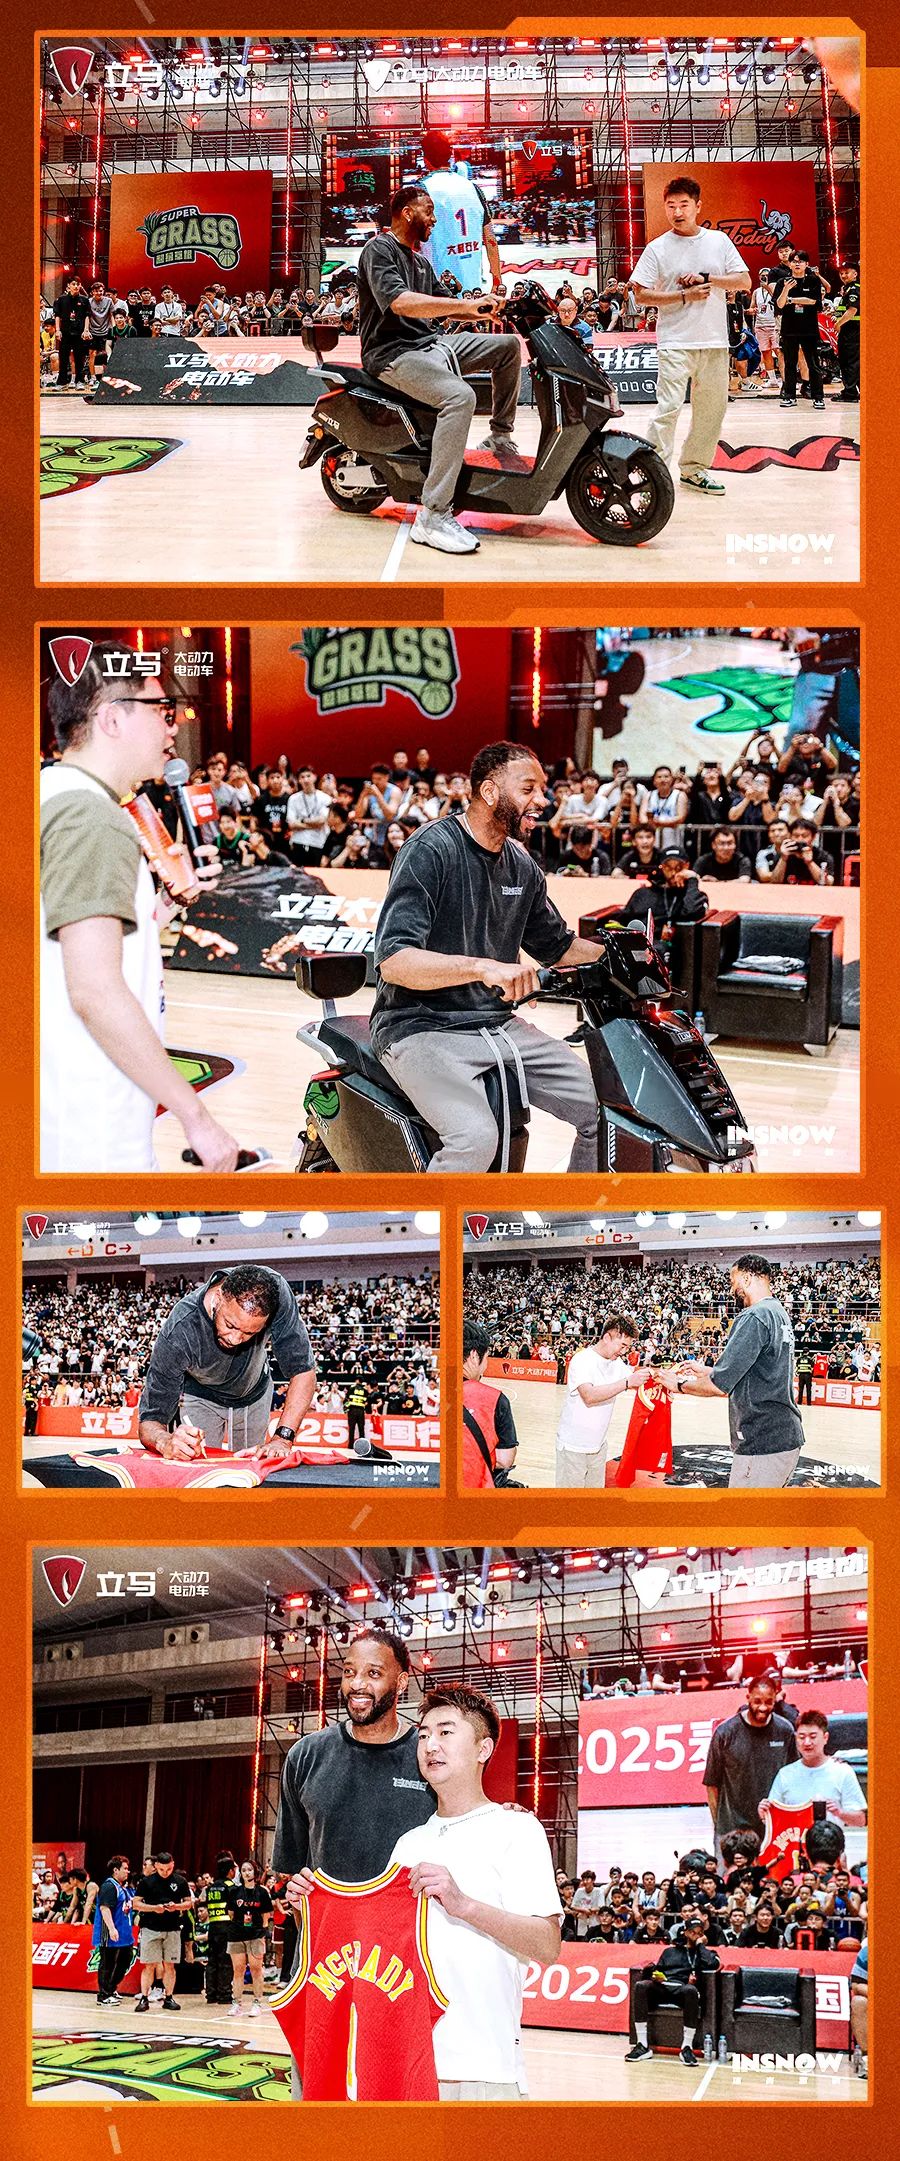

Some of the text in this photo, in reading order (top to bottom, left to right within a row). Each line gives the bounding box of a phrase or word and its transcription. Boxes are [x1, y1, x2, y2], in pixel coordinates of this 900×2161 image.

[160, 208, 198, 224] SUPER
[150, 217, 238, 253] GRASS
[164, 352, 282, 368] 立马大动力
[181, 371, 257, 386] 电动车
[312, 627, 453, 689] GRASS
[296, 925, 376, 953] 电动
[613, 1233, 622, 1243] C
[105, 1243, 117, 1255] C
[32, 1941, 81, 1967] 国行
[521, 1961, 631, 2004] 2025
